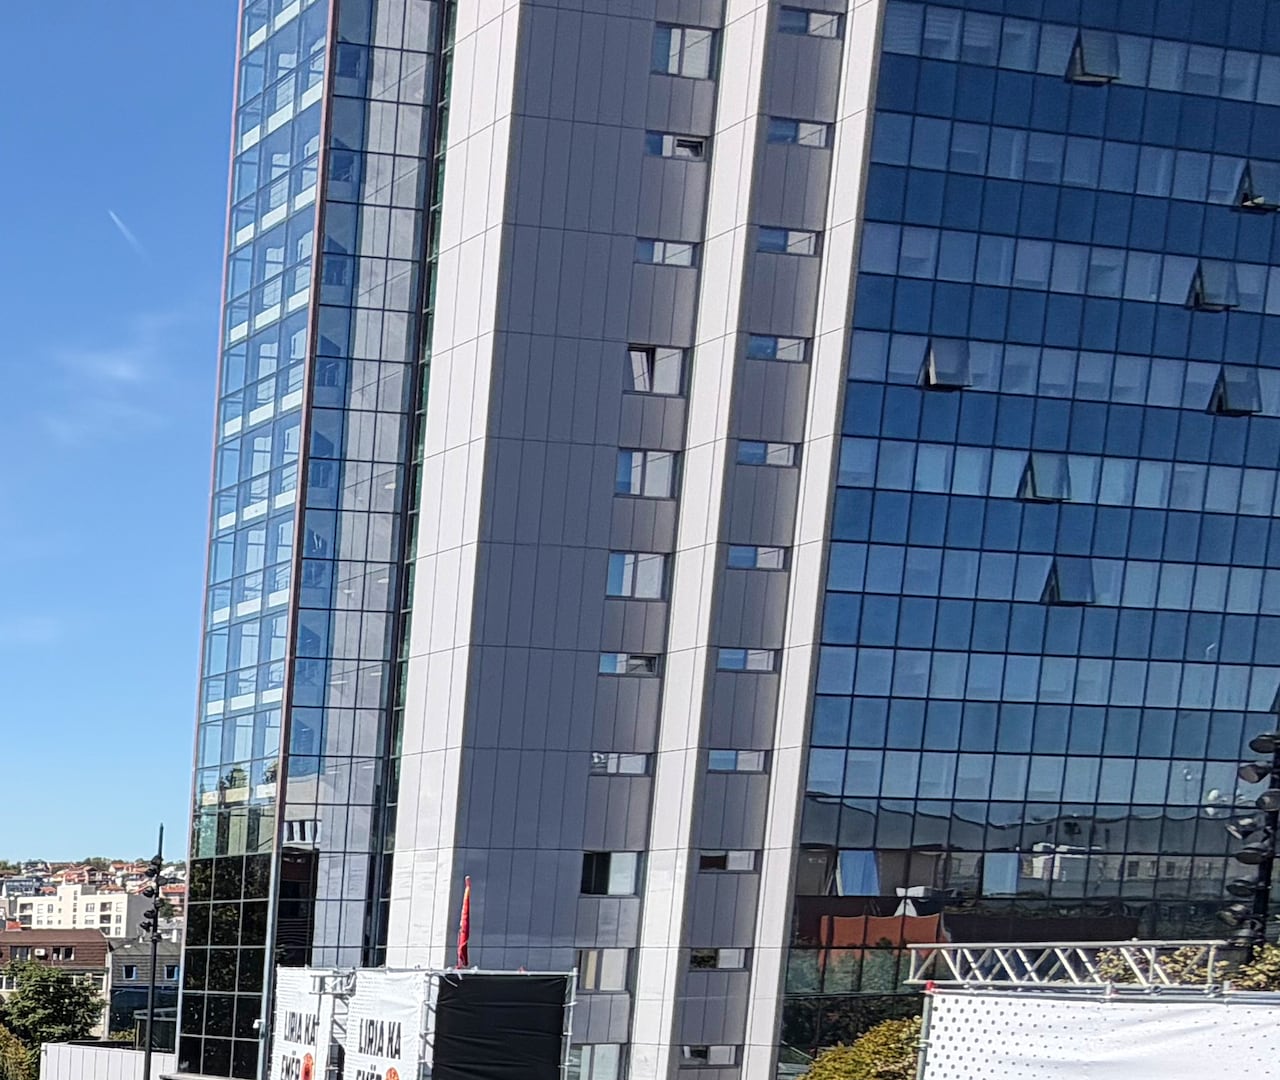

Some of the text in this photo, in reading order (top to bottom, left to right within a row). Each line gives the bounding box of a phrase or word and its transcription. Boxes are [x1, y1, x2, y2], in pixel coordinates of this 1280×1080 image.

[284, 1010, 301, 1044] LIRIA
[358, 1018, 402, 1060] LIRIA KA
